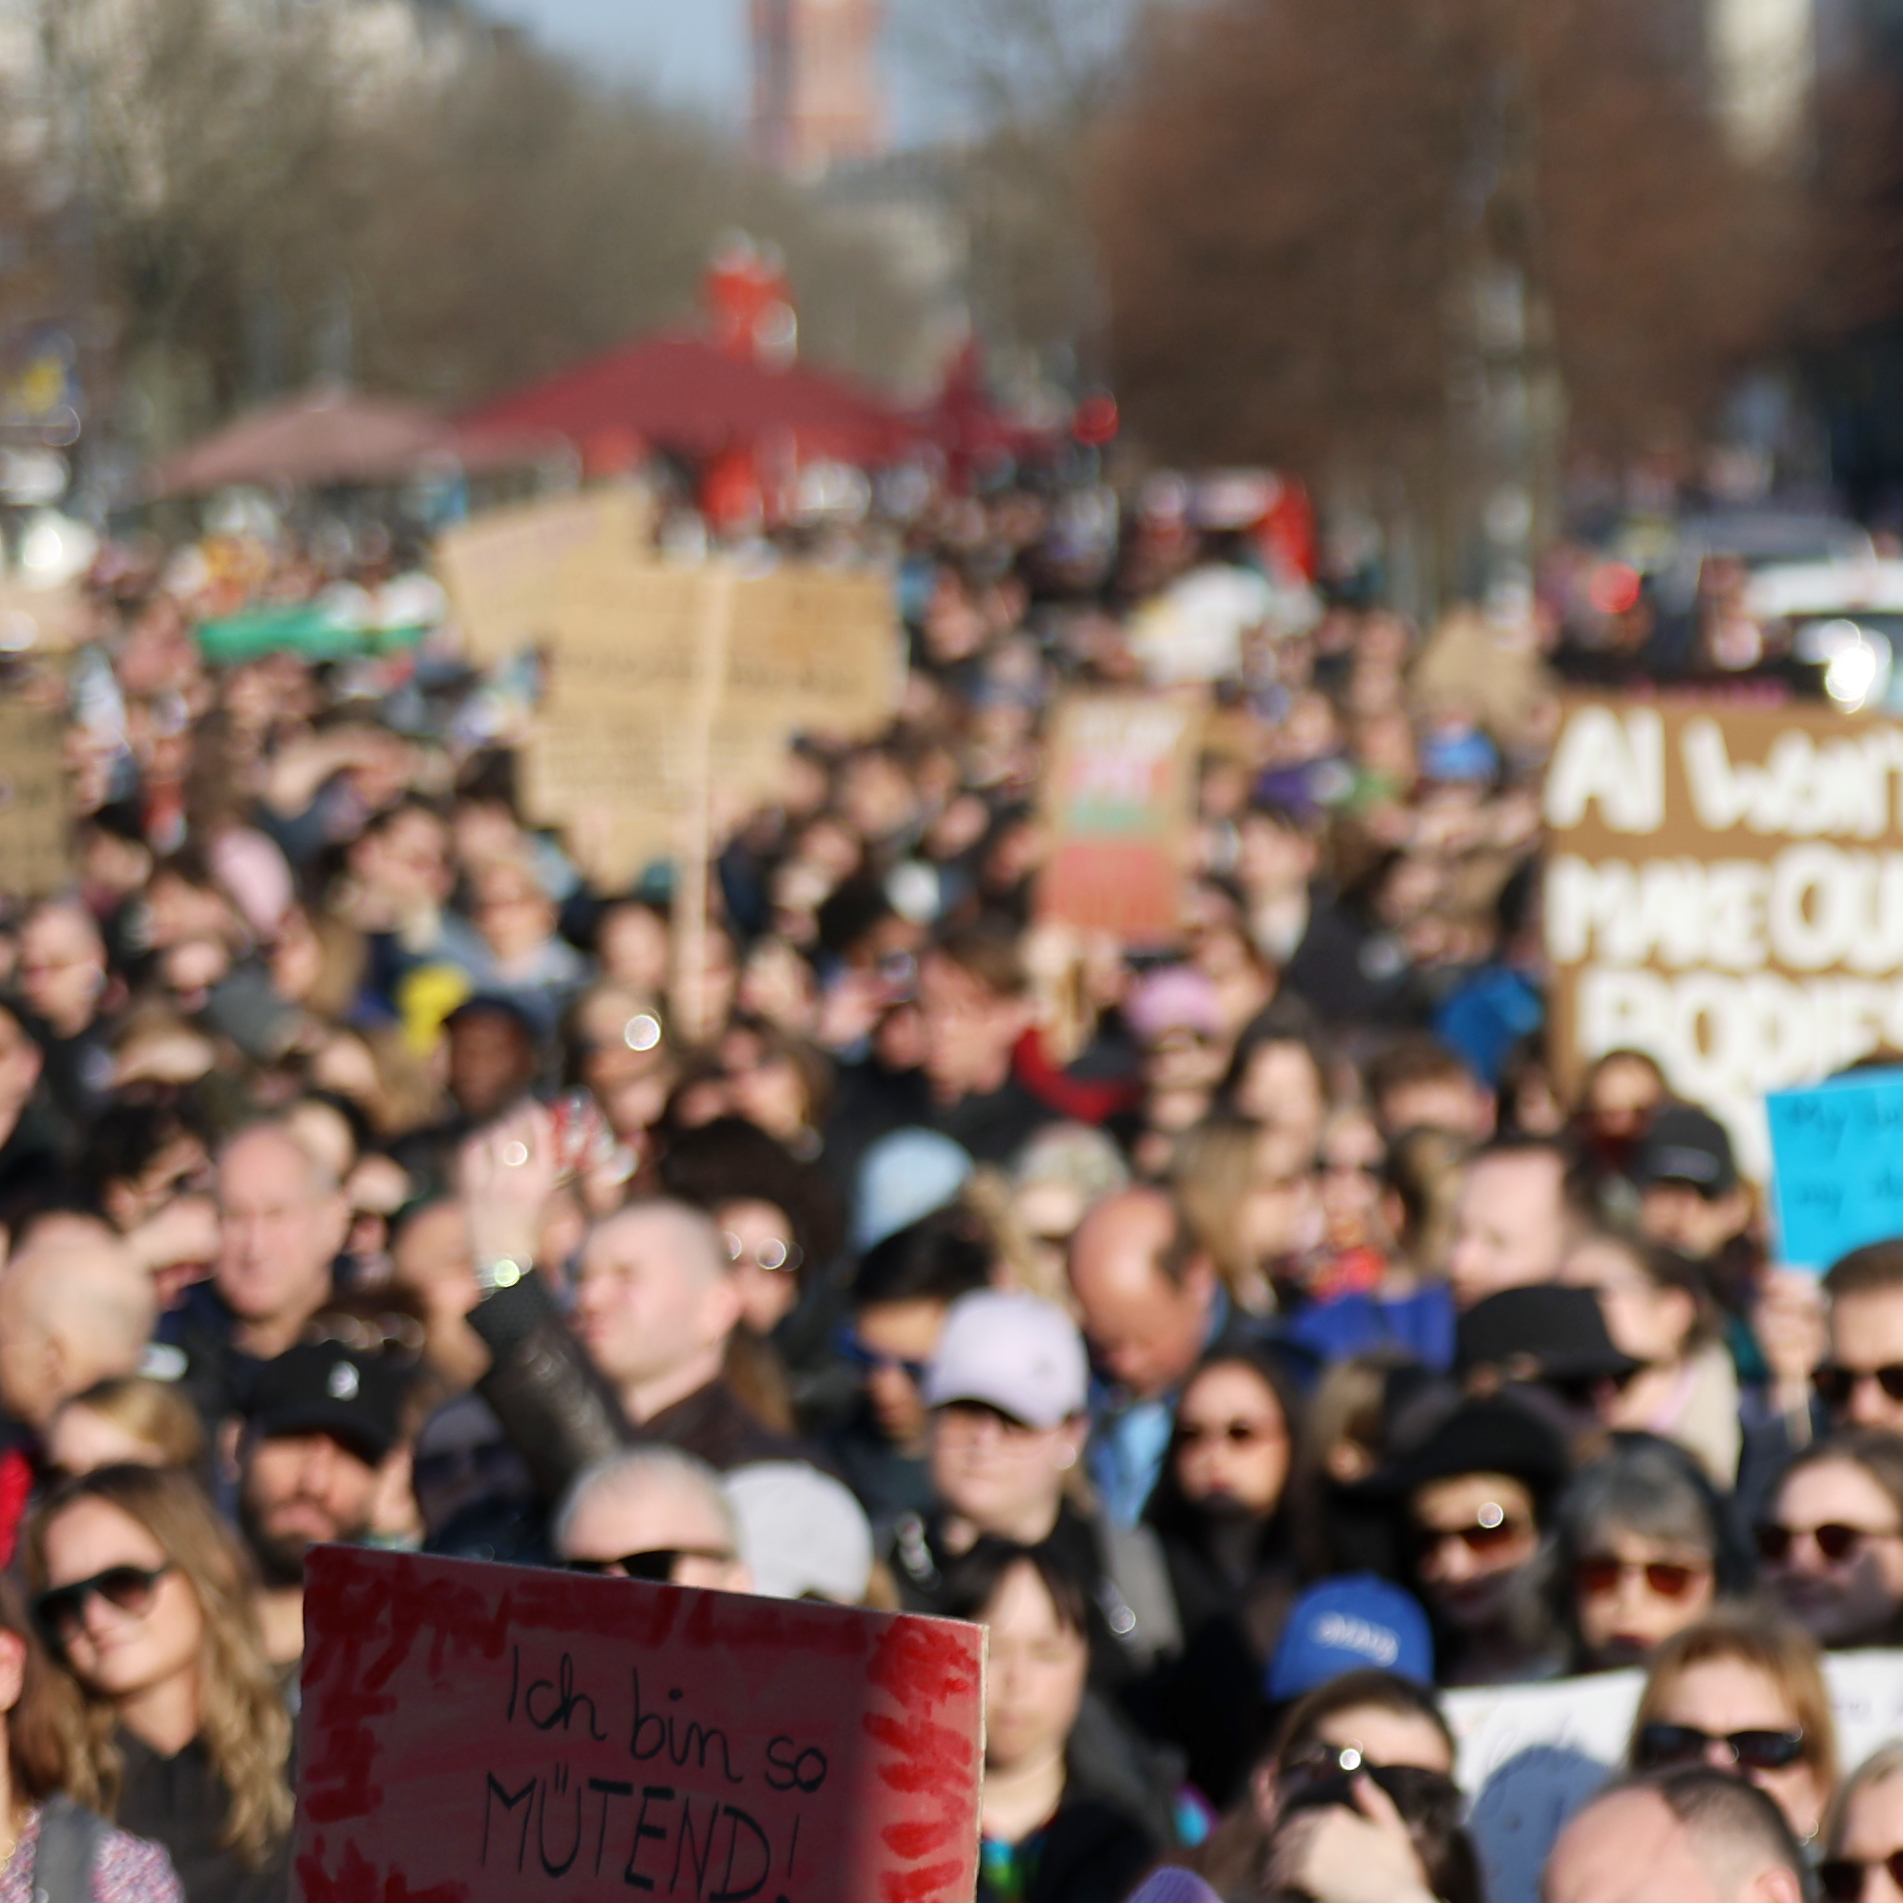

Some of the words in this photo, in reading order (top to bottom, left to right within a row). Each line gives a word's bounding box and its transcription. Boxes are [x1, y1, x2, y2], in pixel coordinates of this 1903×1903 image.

[1543, 706, 1665, 833] AI
[1544, 852, 1768, 968] MAKE
[508, 1644, 607, 1742] Ich
[630, 1667, 744, 1784] bin
[764, 1735, 827, 1794] so
